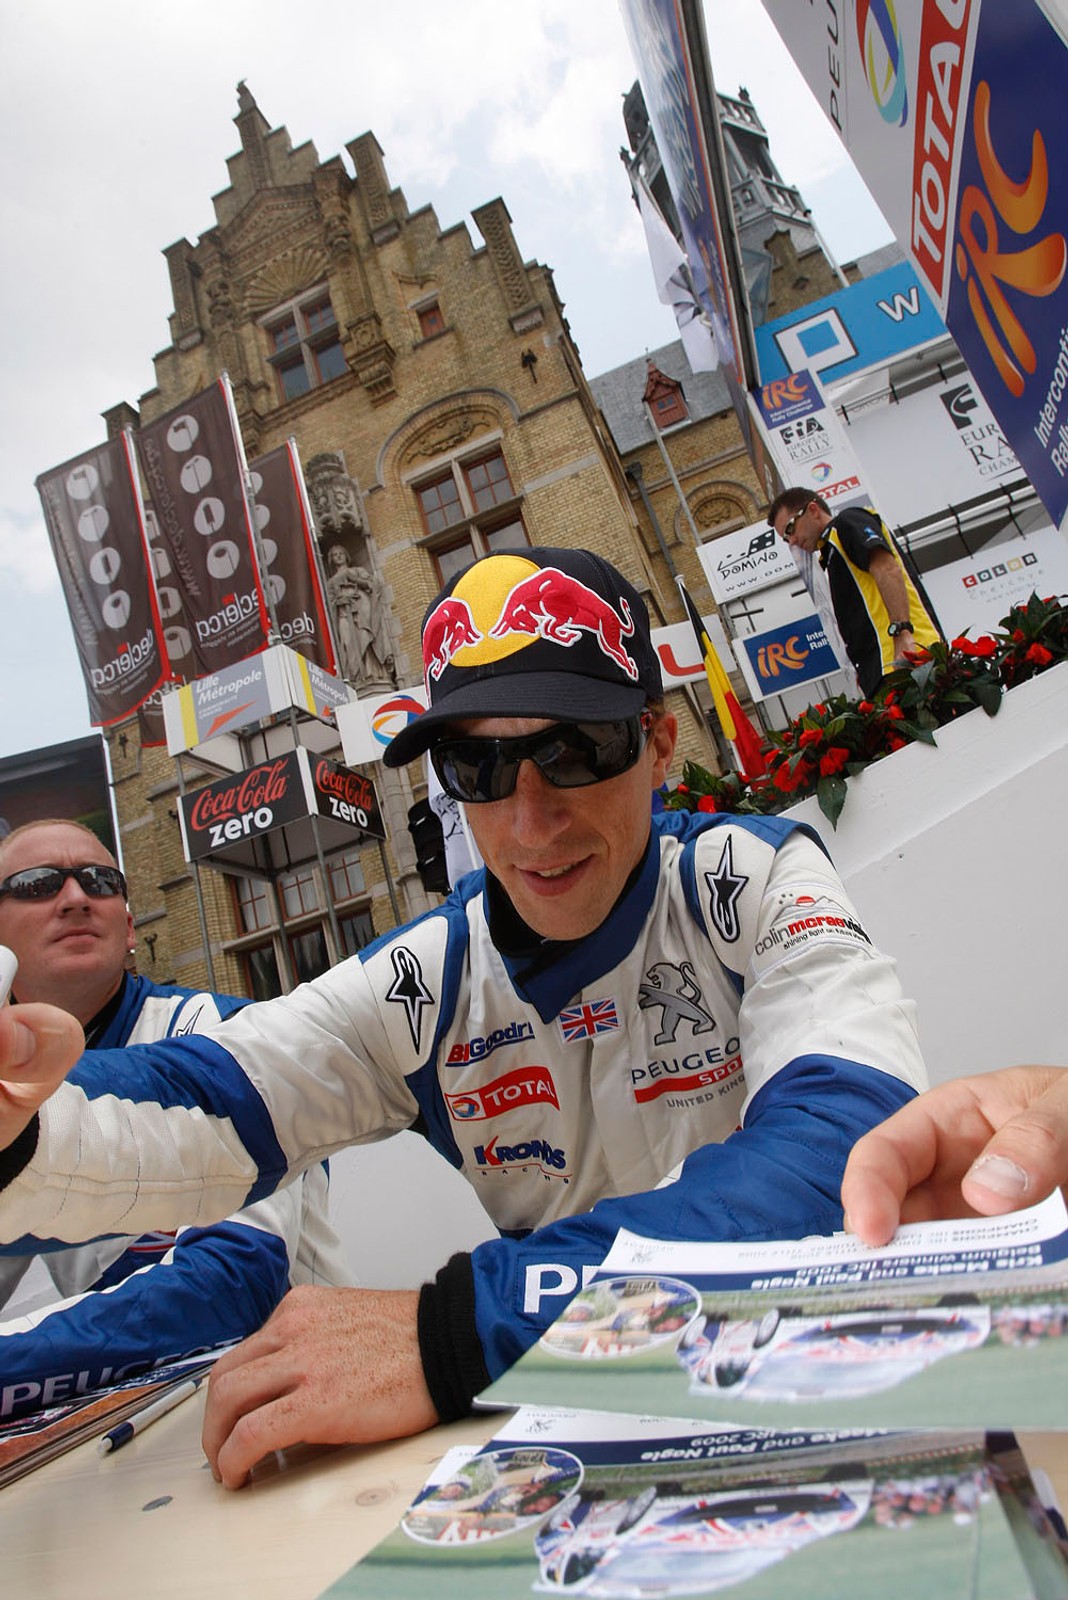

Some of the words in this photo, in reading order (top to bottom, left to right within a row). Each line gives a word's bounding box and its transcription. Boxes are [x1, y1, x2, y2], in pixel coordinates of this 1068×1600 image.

[960, 423, 1000, 446] EUR
[789, 439, 831, 461] RALLY
[196, 673, 220, 694] Lille
[198, 668, 264, 706] Métropole
[191, 757, 290, 831] Coca-Cola
[315, 760, 374, 812] Coca-Cola
[328, 796, 369, 828] zero
[208, 806, 274, 848] zero
[630, 1036, 741, 1085] PEUGEO
[698, 1059, 740, 1086] SPO
[484, 1080, 556, 1107] TOTAL
[666, 1092, 715, 1109] UNITED
[961, 1243, 1042, 1261] Belgium
[999, 1253, 1044, 1269] Kris
[868, 1268, 909, 1281] and
[690, 1434, 740, 1448] 2009
[706, 1440, 758, 1457] Paul
[762, 1435, 805, 1450] and
[640, 1447, 700, 1463] Nagle
